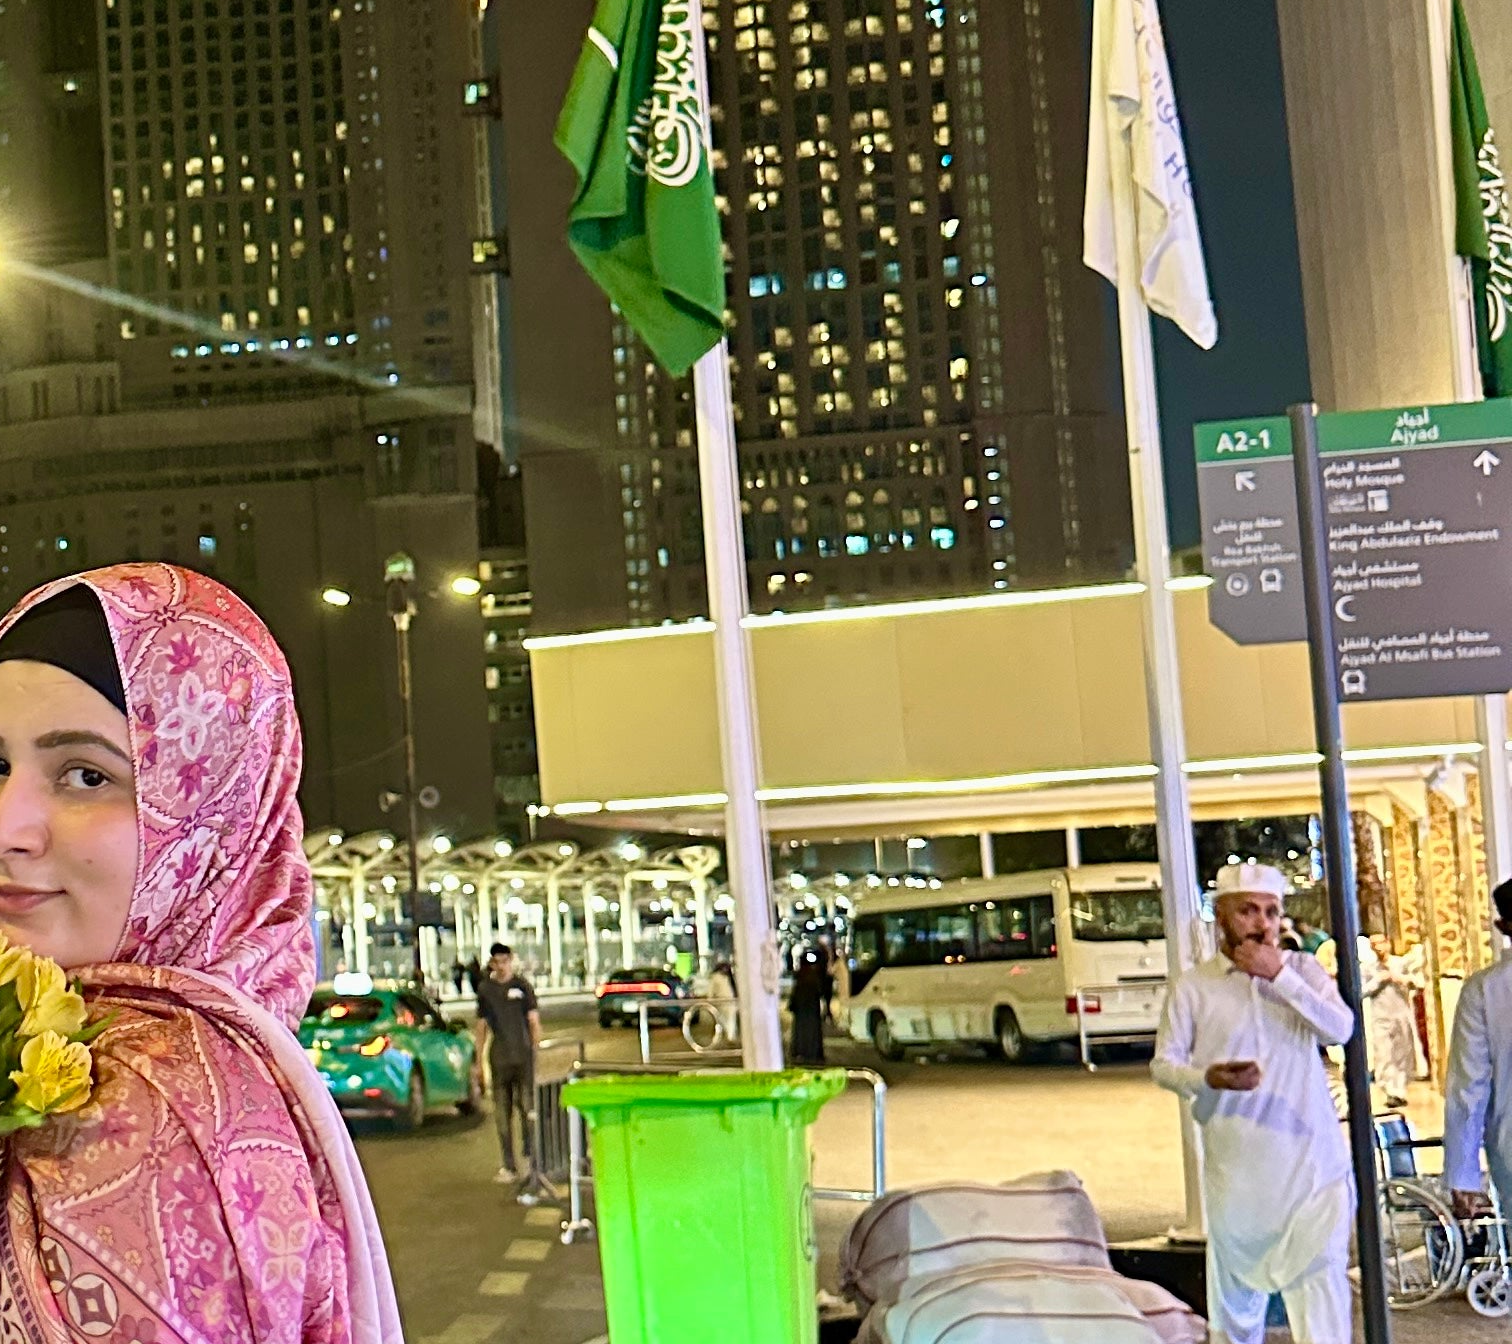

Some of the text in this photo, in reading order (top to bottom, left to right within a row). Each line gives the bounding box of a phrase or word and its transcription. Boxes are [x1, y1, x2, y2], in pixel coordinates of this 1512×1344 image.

[1396, 406, 1430, 428] أجياد
[1216, 429, 1271, 454] A2-1
[1390, 425, 1440, 446] Ajyad
[1325, 473, 1405, 490] Holy Mosque
[1329, 528, 1500, 553] King Abdulaziz Endowment
[1333, 574, 1423, 593] Ajyad Hospital
[1340, 652, 1376, 667] Ajyad
[1378, 650, 1392, 664] Al
[1431, 646, 1454, 661] Bus
[1456, 644, 1502, 660] Station
